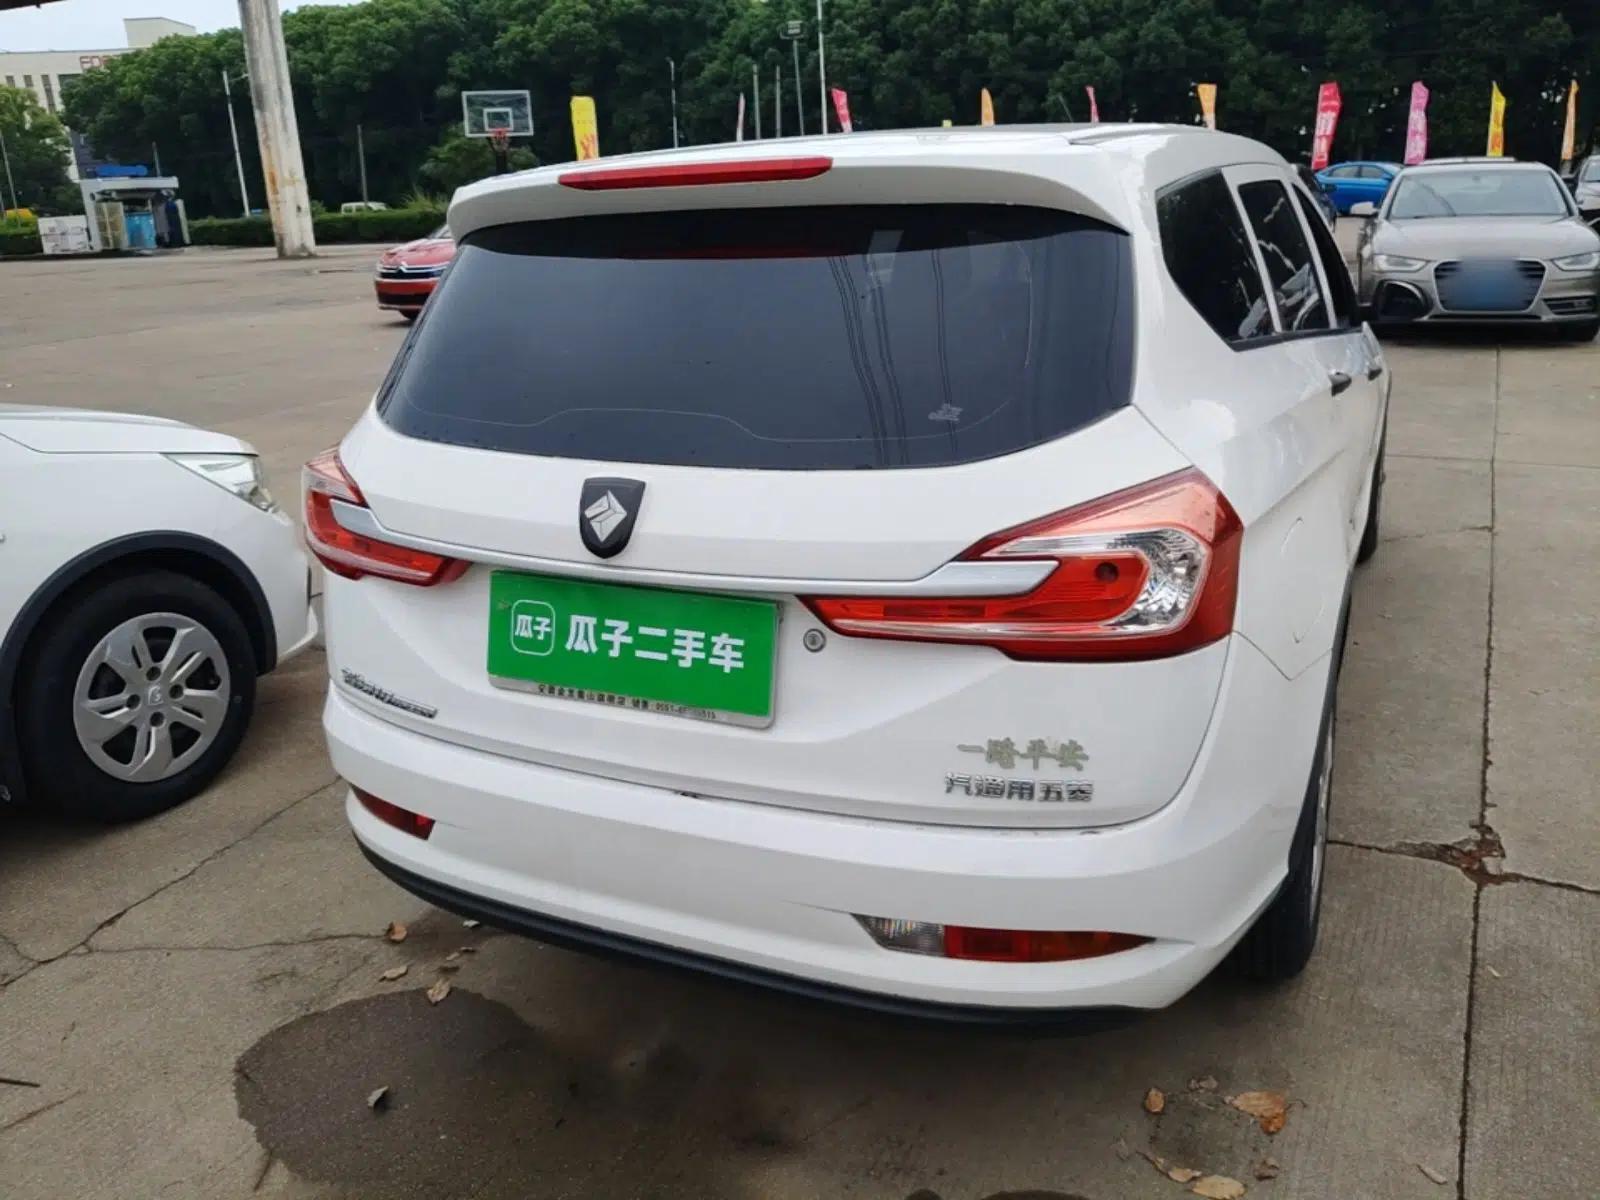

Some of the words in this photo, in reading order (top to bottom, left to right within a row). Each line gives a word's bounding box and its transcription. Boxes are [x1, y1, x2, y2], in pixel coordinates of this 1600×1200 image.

[515, 614, 552, 640] 瓜子
[566, 614, 745, 674] 瓜子二手车
